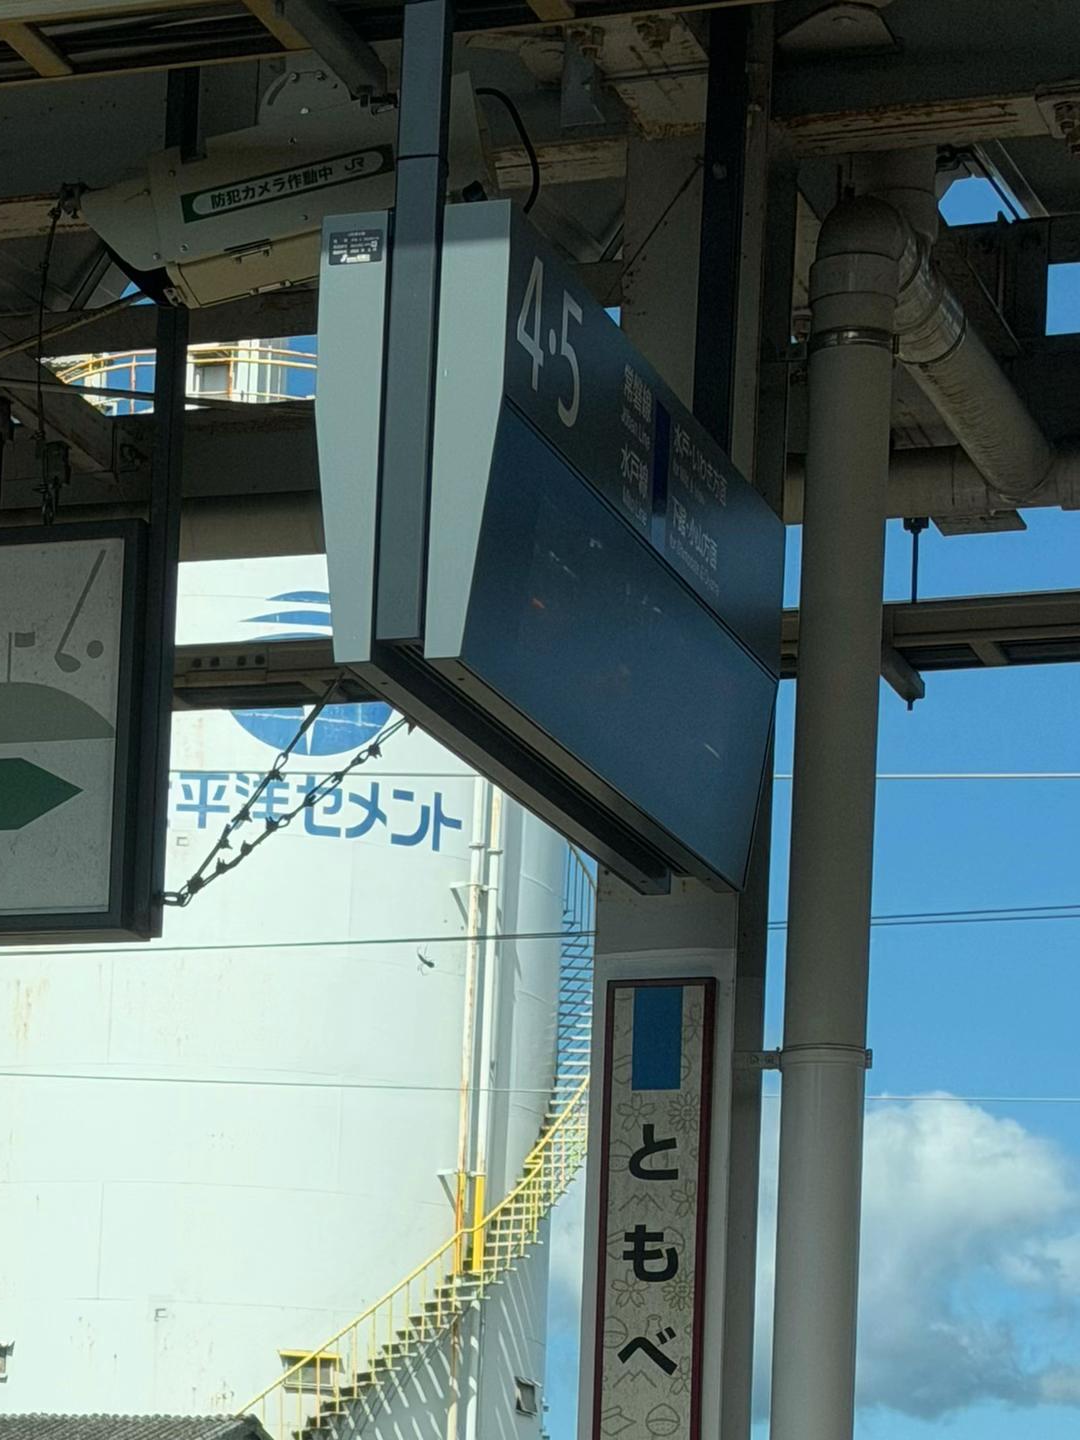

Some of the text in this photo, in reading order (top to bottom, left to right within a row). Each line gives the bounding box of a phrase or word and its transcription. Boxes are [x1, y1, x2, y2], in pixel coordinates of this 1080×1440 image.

[211, 166, 333, 209] 防犯カメラ作動中
[345, 156, 365, 171] JR
[168, 772, 463, 851] 平洋セメント
[617, 1123, 679, 1376] ともべ
